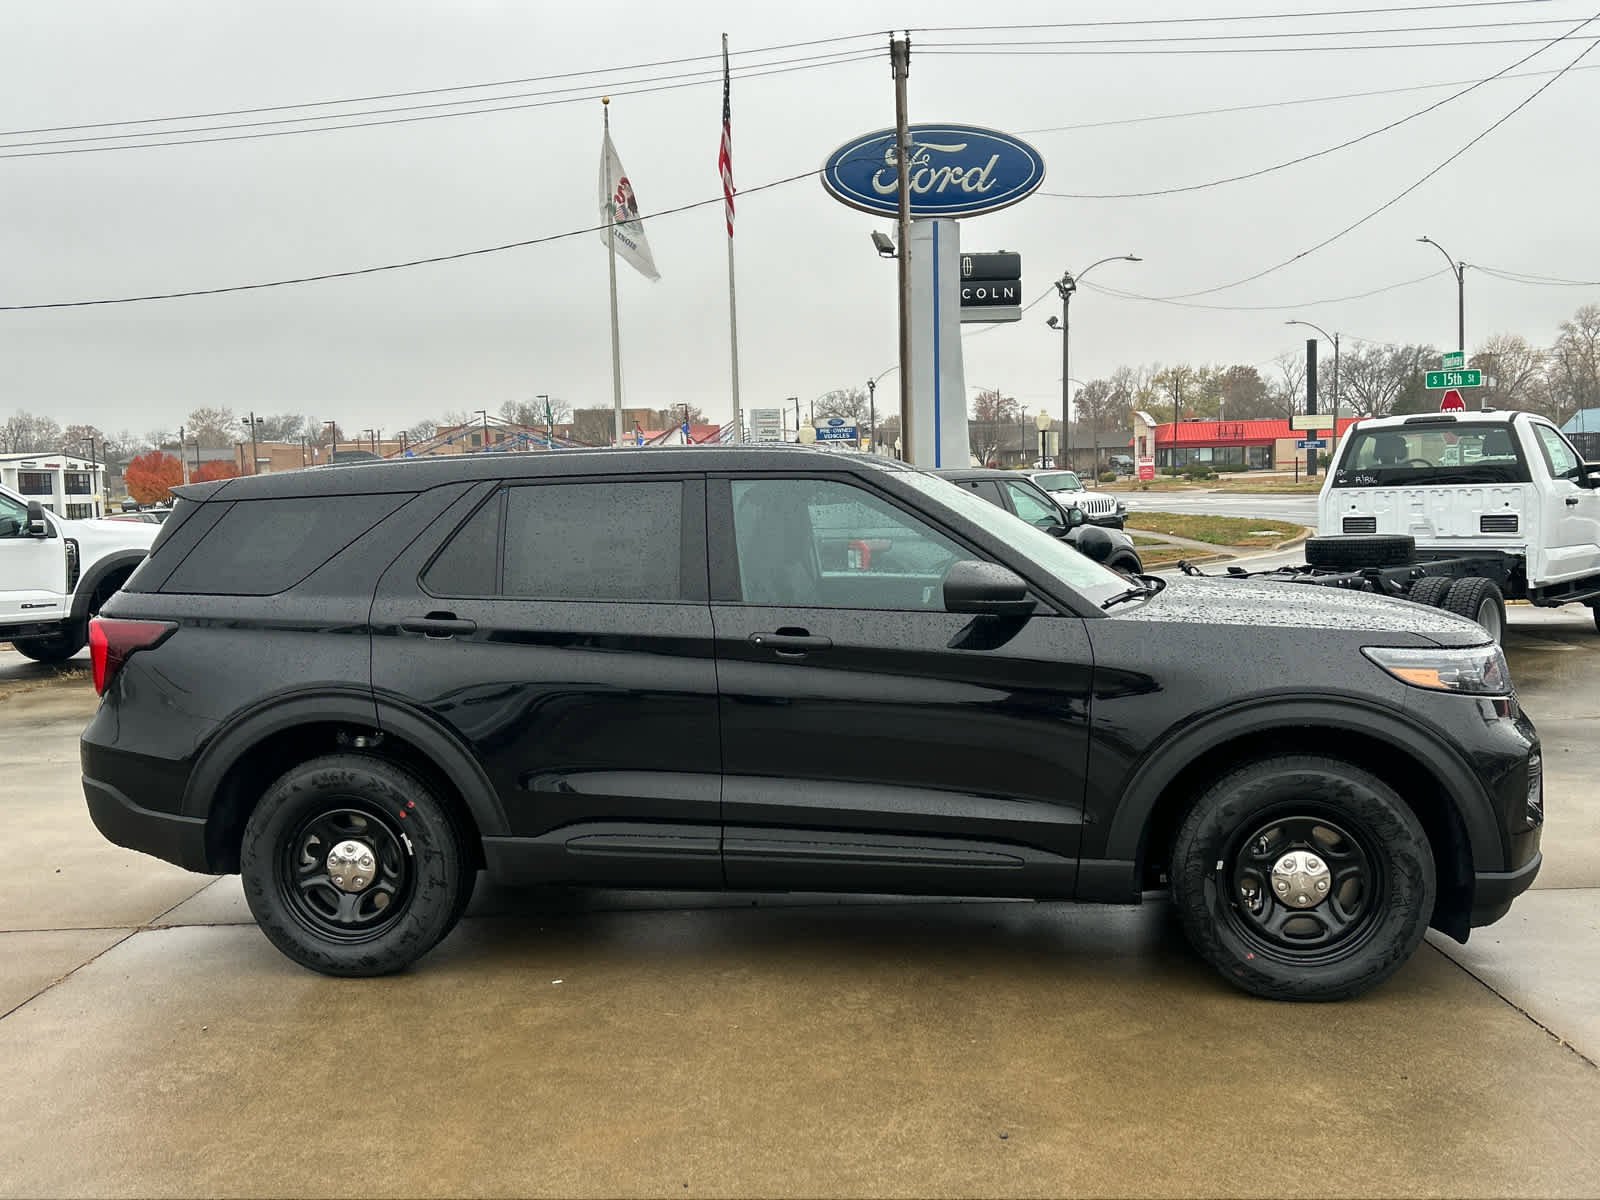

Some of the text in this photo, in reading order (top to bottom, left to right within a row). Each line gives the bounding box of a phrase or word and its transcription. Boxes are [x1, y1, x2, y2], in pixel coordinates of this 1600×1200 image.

[962, 287, 1014, 299] COLN
[1432, 373, 1475, 385] S 15th St
